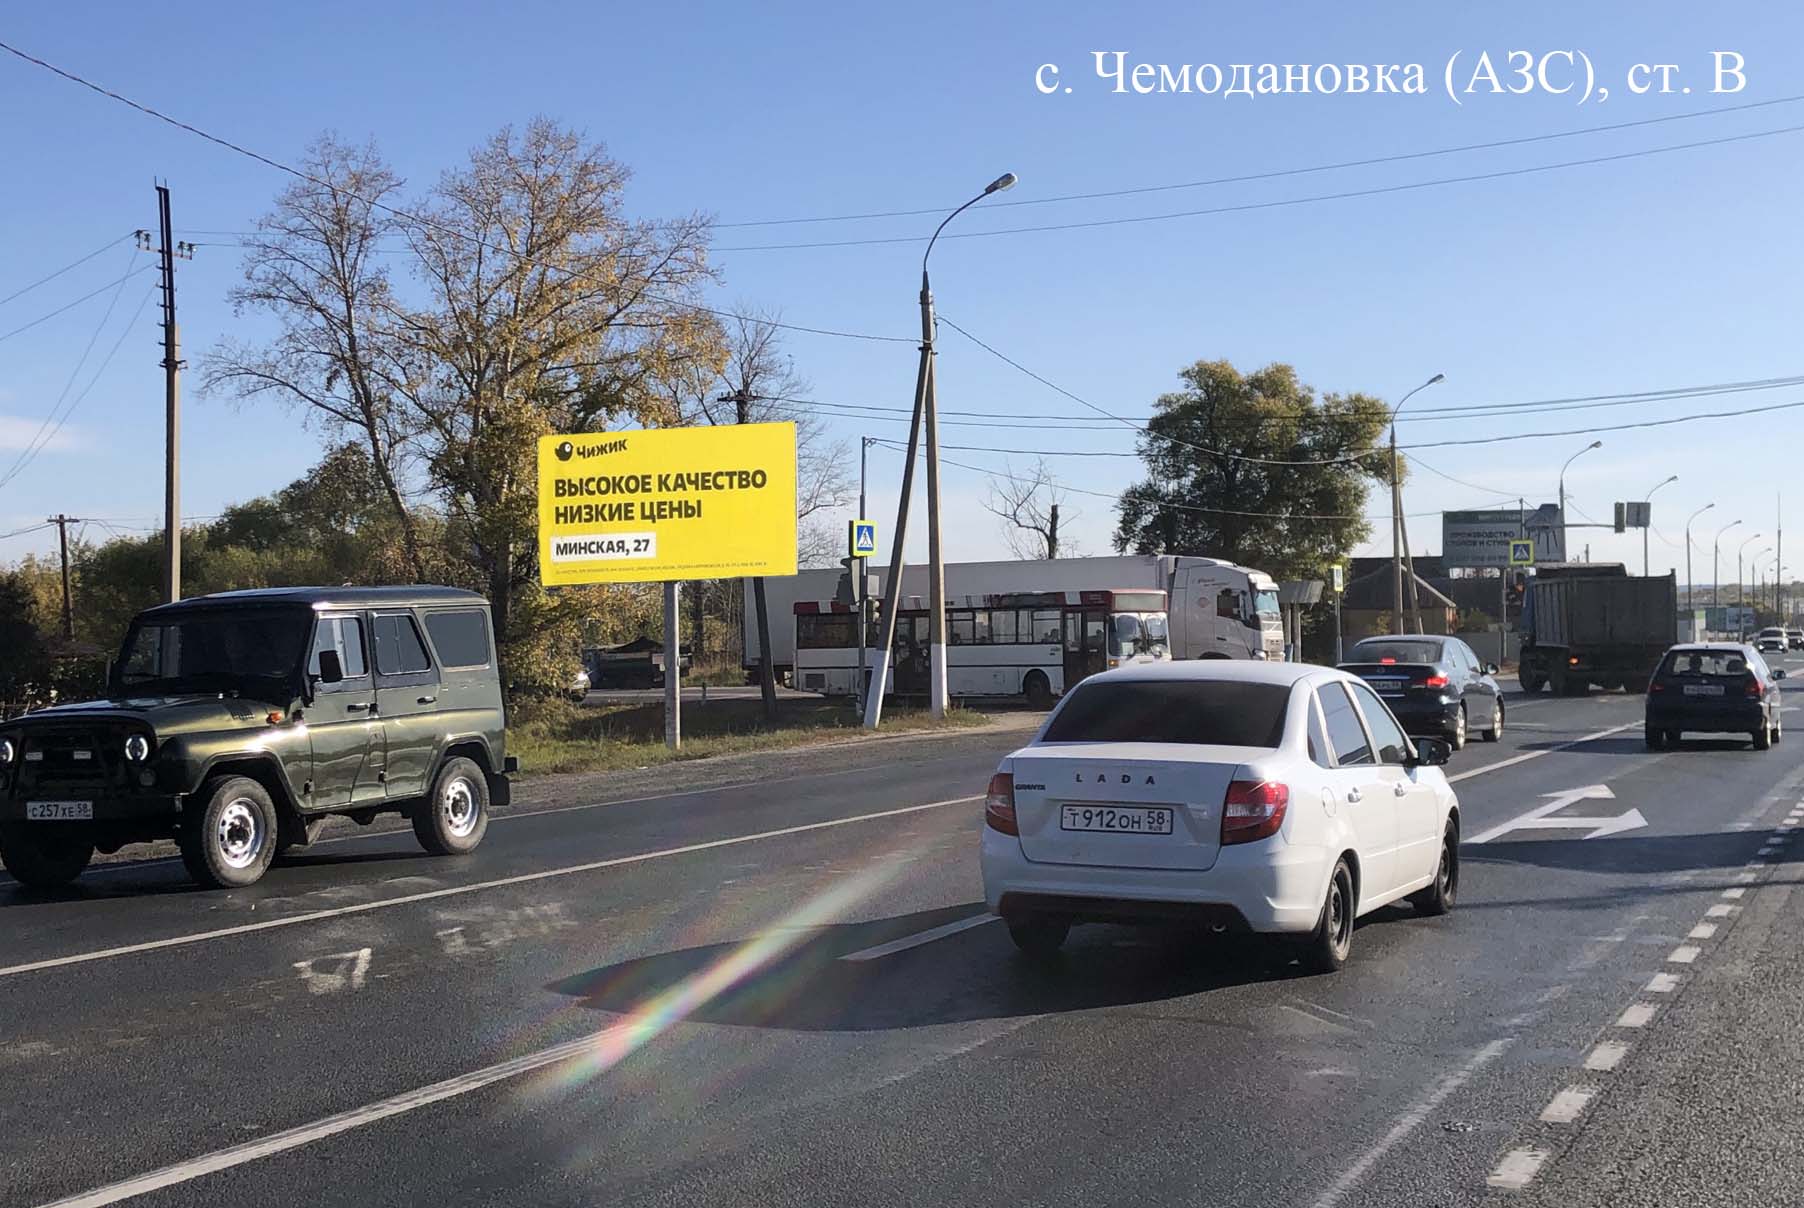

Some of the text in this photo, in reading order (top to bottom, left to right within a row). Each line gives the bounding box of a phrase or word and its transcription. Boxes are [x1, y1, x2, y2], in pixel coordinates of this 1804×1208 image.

[554, 469, 767, 497] ВЫСОКОЕ КАЧЕСТВО
[554, 499, 702, 525] НИЗКИЕ ЦЕНЫ
[555, 538, 650, 556] МИНСКАЯ, 27
[1076, 774, 1156, 786] LADA
